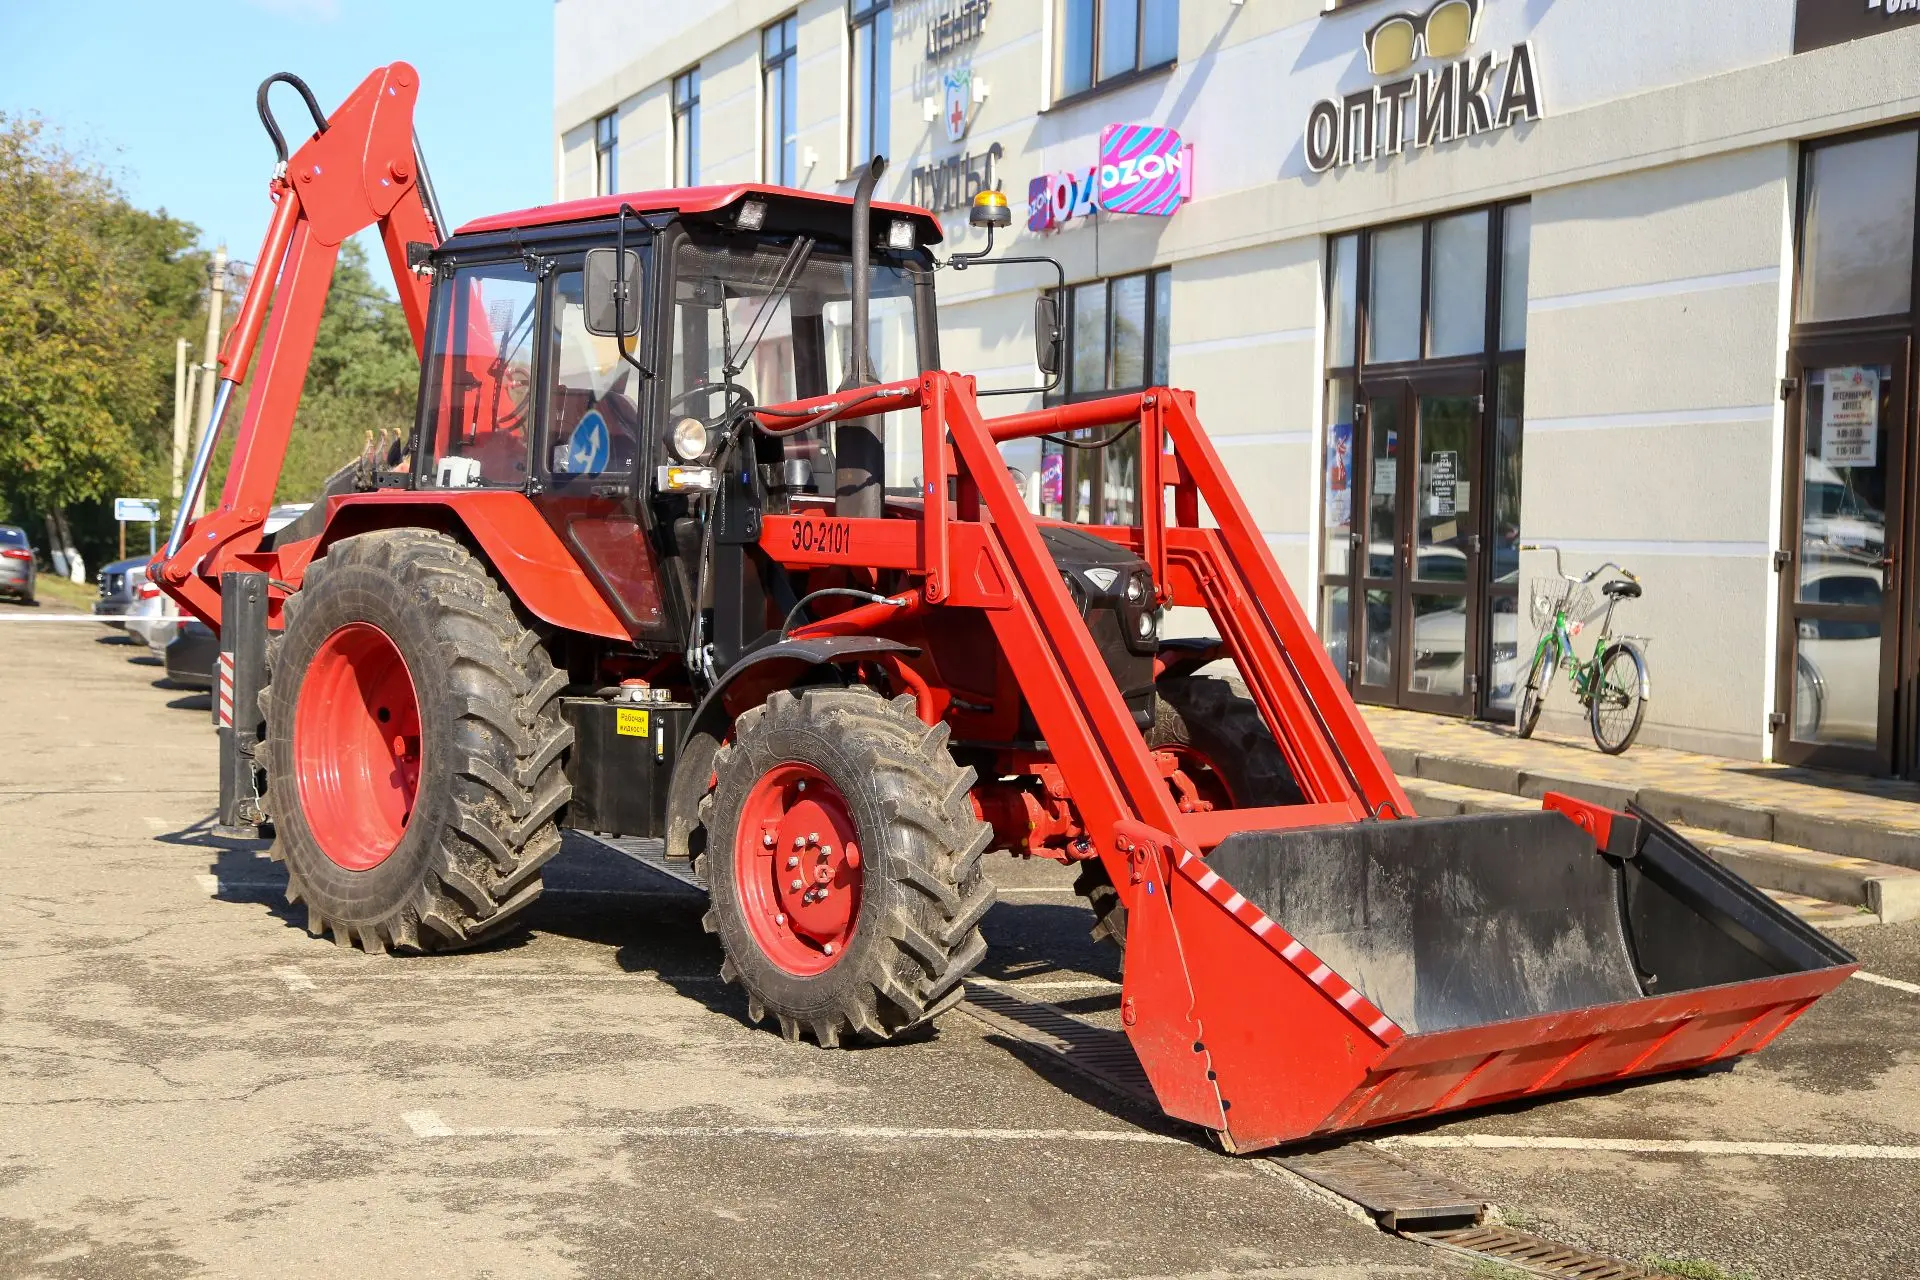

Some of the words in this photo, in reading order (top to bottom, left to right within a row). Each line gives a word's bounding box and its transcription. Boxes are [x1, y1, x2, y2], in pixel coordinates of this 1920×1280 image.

[926, 0, 989, 64] ЦЕНТР
[1305, 39, 1543, 172] ОПТИКА
[911, 142, 1003, 212] ПУЛЬС
[1102, 151, 1182, 188] OZON
[792, 520, 850, 554] ЭО-2101
